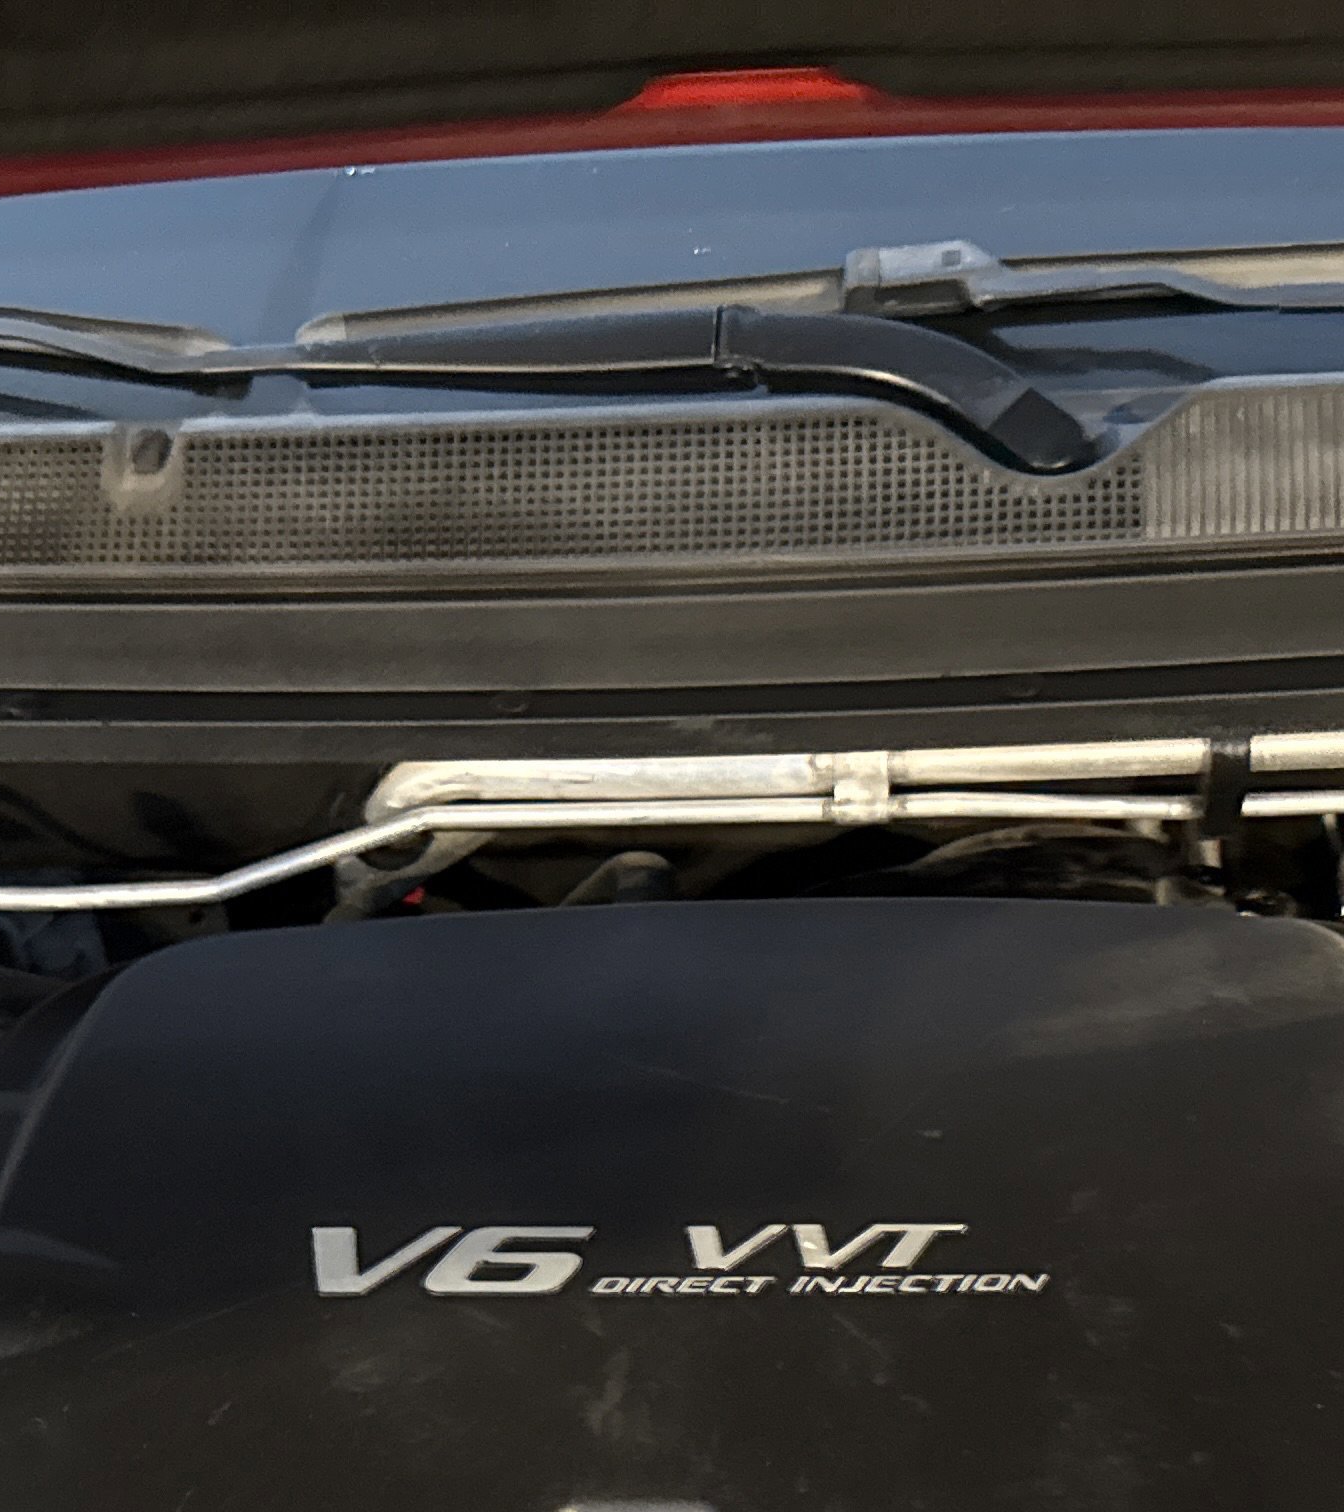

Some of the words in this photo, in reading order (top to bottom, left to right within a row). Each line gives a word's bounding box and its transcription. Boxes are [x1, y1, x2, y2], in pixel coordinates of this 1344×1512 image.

[311, 1226, 596, 1297] V6
[684, 1223, 969, 1271] VVT
[589, 1275, 777, 1295] DIRECT
[787, 1272, 1052, 1295] INJECTION
